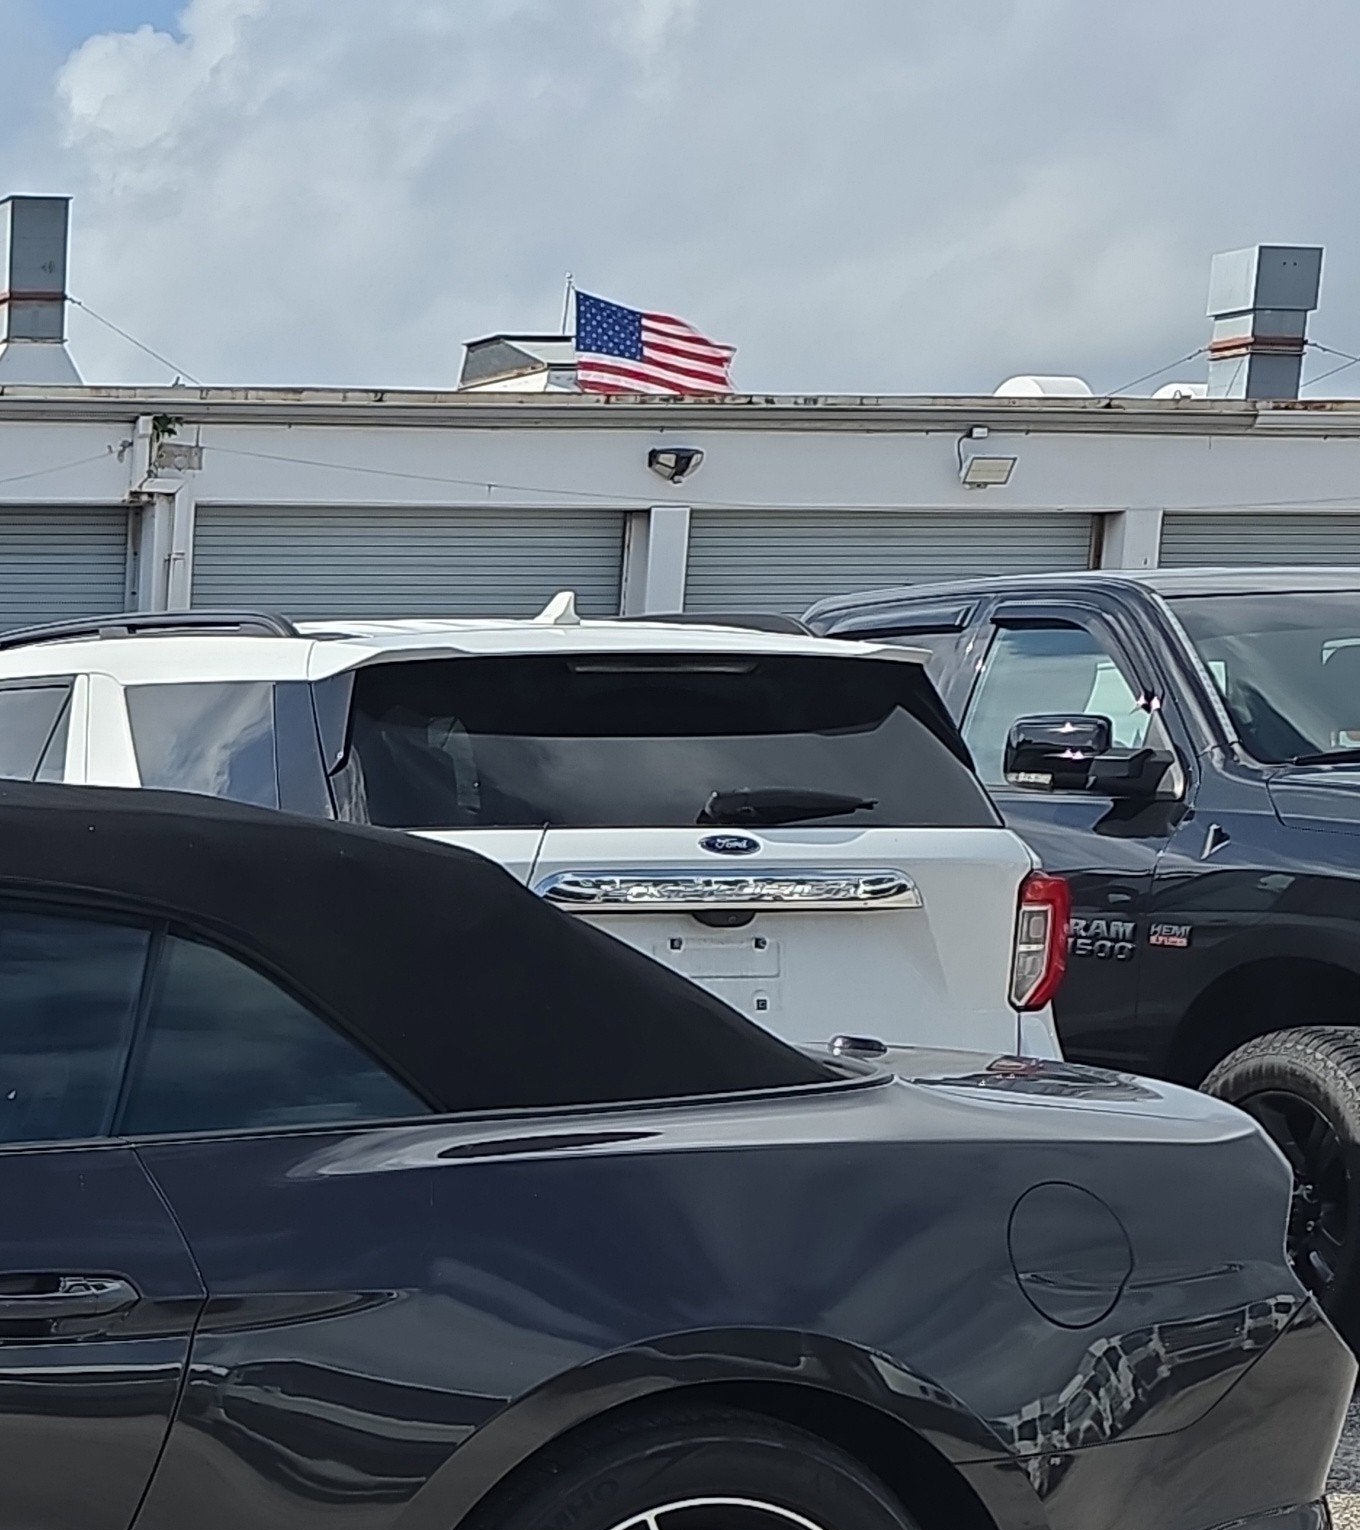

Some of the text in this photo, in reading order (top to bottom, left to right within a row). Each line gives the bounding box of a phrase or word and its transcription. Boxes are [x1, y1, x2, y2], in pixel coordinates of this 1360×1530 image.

[715, 838, 748, 849] Ford
[1069, 918, 1136, 939] RAM
[1149, 923, 1192, 937] HEMI
[1067, 938, 1136, 959] 1500
